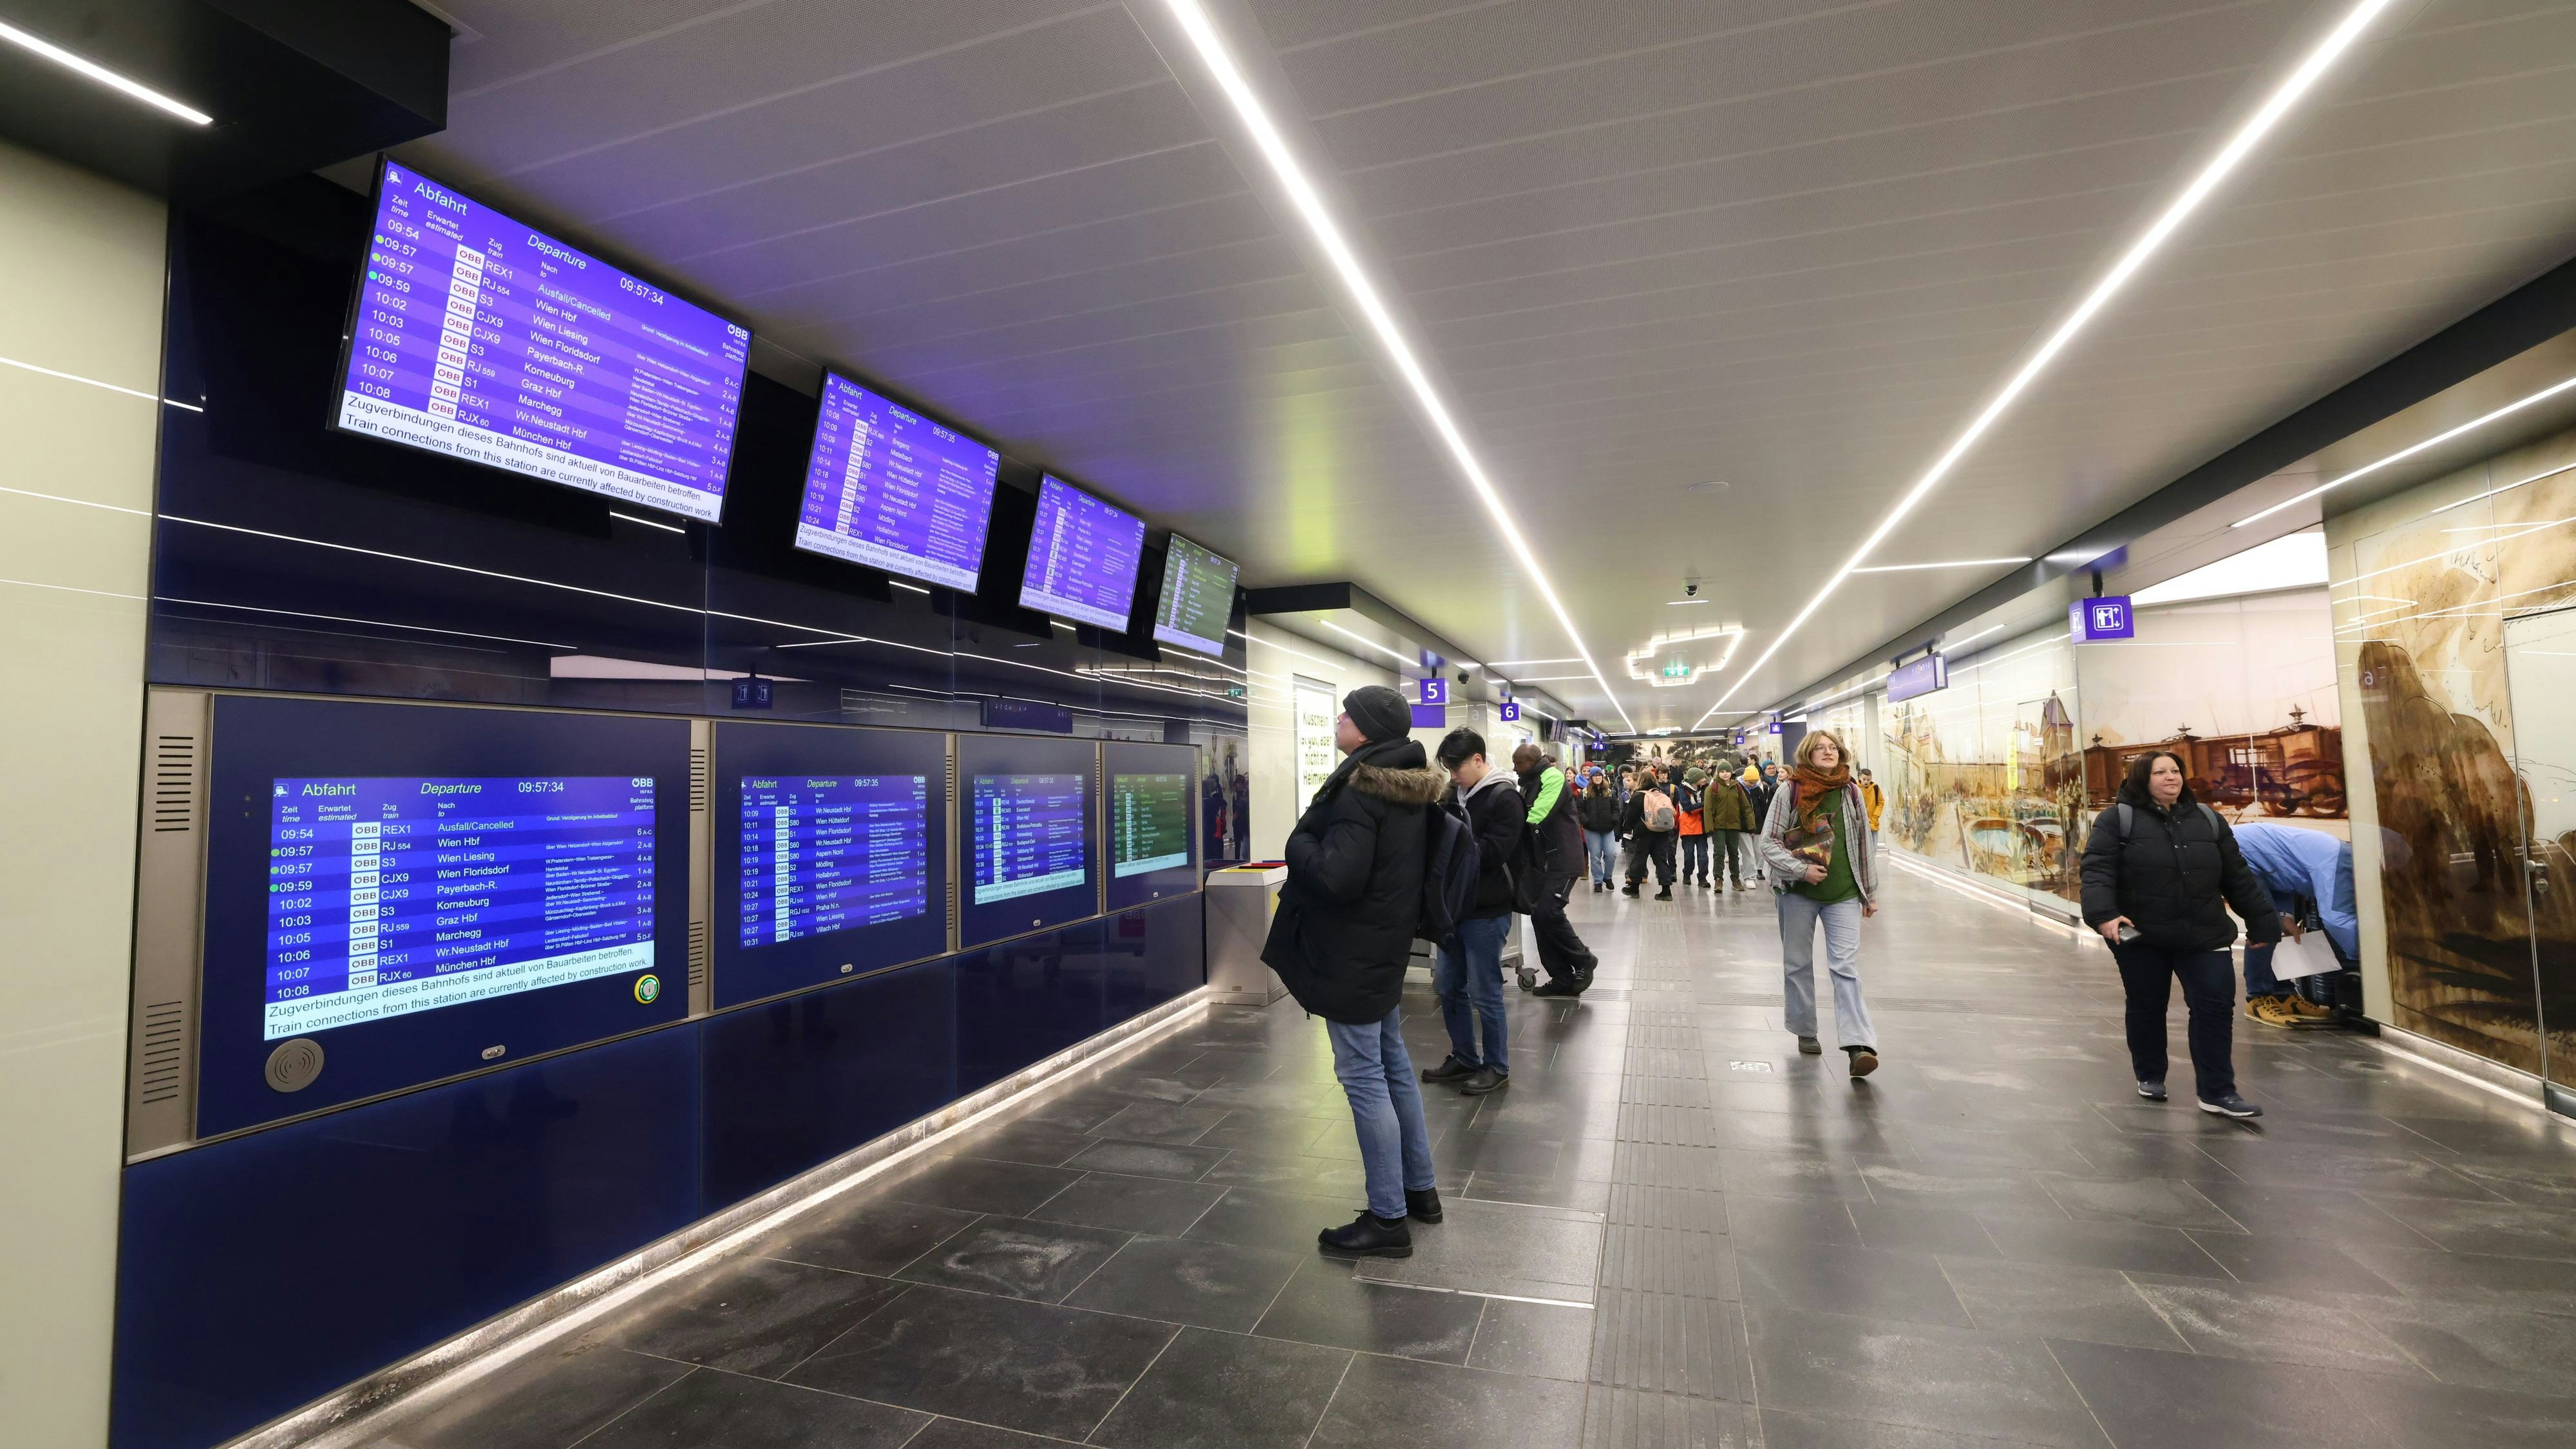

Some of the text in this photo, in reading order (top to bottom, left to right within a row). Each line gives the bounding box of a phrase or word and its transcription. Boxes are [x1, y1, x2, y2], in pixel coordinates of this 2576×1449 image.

[388, 220, 419, 241] 09:54
[486, 261, 513, 280] REX1
[538, 284, 611, 321] Ausfall/Cancelled
[392, 195, 744, 359] Zeit Erwartet Zug Nach Bahnsteig
[414, 183, 468, 216] Abfahrt
[527, 234, 587, 270] Departure
[620, 278, 664, 306] 09:57:34
[381, 256, 414, 275] 09:57
[479, 294, 493, 307] S3
[533, 315, 556, 332] Wien
[558, 325, 589, 346] Liesing
[384, 238, 417, 258] 09:57
[482, 277, 497, 290] RJ
[497, 285, 510, 296] 554
[536, 299, 559, 316] Wien
[561, 309, 578, 323] Hbf
[391, 205, 409, 218] time
[426, 222, 464, 242] estimated
[488, 248, 504, 259] train
[724, 353, 744, 364] platform
[373, 310, 575, 390] 10:03 S3 Korneuburg
[376, 292, 585, 375] 10:02 CJX9 Payerbach-R.
[378, 274, 601, 365] 09:59 CJX9 Wien Floridsdorf
[734, 339, 746, 348] INFRA
[366, 346, 563, 418] 10:06 S1 Marchegg
[370, 328, 562, 399] 10:05 RJ 559 Graz Hbf
[360, 382, 391, 399] 10:08
[458, 410, 480, 425] RJX
[480, 419, 489, 428] 60
[513, 426, 554, 446] München
[556, 439, 573, 451] Hbf
[363, 364, 588, 439] 10:07 REX1 Wr.Neustadt Hbf
[824, 421, 838, 432] 10:09
[838, 383, 956, 443] Abfahrt Departure 09:57:35
[346, 413, 712, 518] Train connections from this station are currently affected by construction work.
[348, 396, 704, 502] Zugverbindungen dieses Bahnhofs sind aktuell von Bauarbeiten betroffen.
[810, 492, 824, 502] 10:19
[813, 480, 827, 491] 10:19
[1427, 683, 1438, 699] 5
[1505, 706, 1514, 718] 6
[302, 784, 356, 797] Abfahrt
[421, 783, 482, 797] Departure
[518, 782, 564, 793] 09:57:34
[752, 779, 878, 790] Abfahrt Departure 09:57:35
[279, 865, 510, 893] 09:59 CJX9 Wien Floridsdorf
[281, 846, 314, 857] 09:57
[383, 841, 396, 851] RJ
[438, 838, 462, 848] Wien
[464, 837, 480, 846] Hbf
[279, 929, 482, 963] 10:06 S1 Marchegg
[744, 914, 759, 923] 10:27
[269, 947, 636, 1018] Zugverbindungen dieses Bahnhofs sind aktuell von Bauarbeiten betroffen.
[269, 958, 649, 1035] Train connections from this station are currently affected by construction work.
